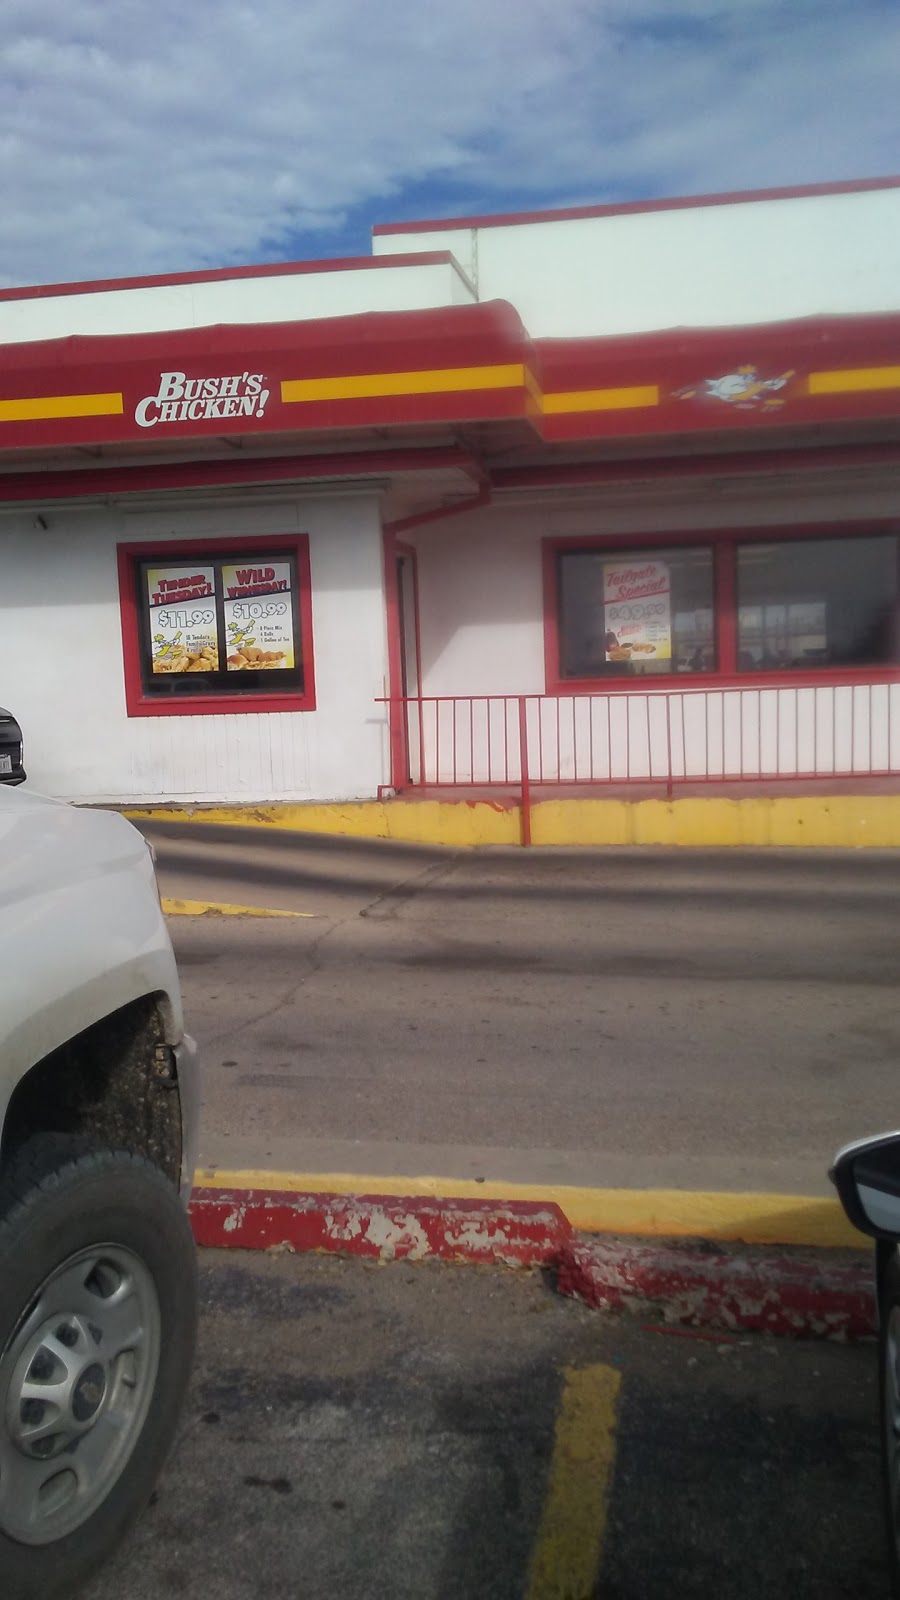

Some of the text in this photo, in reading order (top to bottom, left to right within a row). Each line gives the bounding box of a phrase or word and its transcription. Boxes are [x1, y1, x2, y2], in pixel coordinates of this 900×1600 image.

[158, 371, 264, 400] BUSH'S
[134, 389, 270, 427] CHICKEN!
[158, 575, 206, 592] TENDER
[236, 568, 275, 586] WILD
[617, 576, 666, 599] Special
[158, 610, 214, 628] $11.99
[233, 602, 288, 619] $10.99
